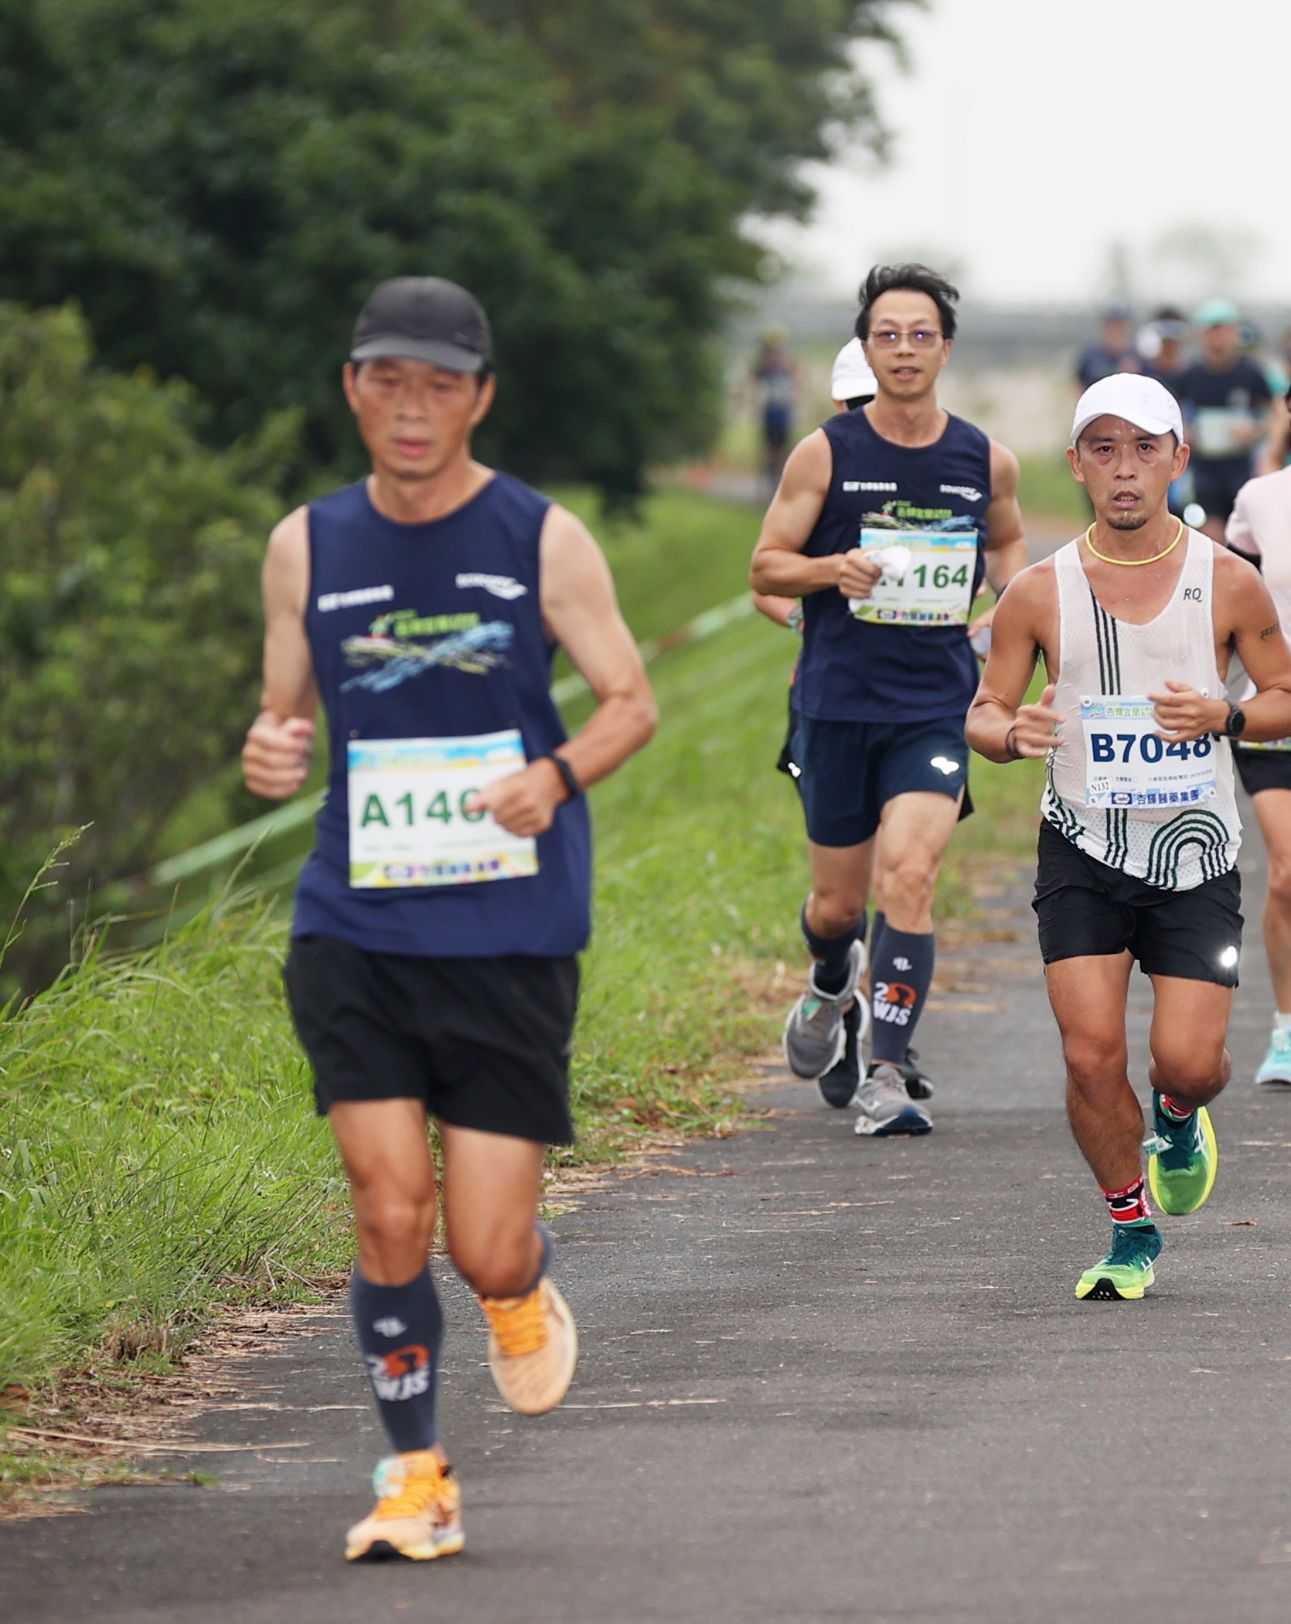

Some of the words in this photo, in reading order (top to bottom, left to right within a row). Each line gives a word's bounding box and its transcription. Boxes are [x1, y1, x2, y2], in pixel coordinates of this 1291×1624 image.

[879, 563, 969, 589] 164
[1183, 587, 1203, 603] RQ
[1090, 732, 1212, 764] B7048
[1091, 781, 1110, 792] N132
